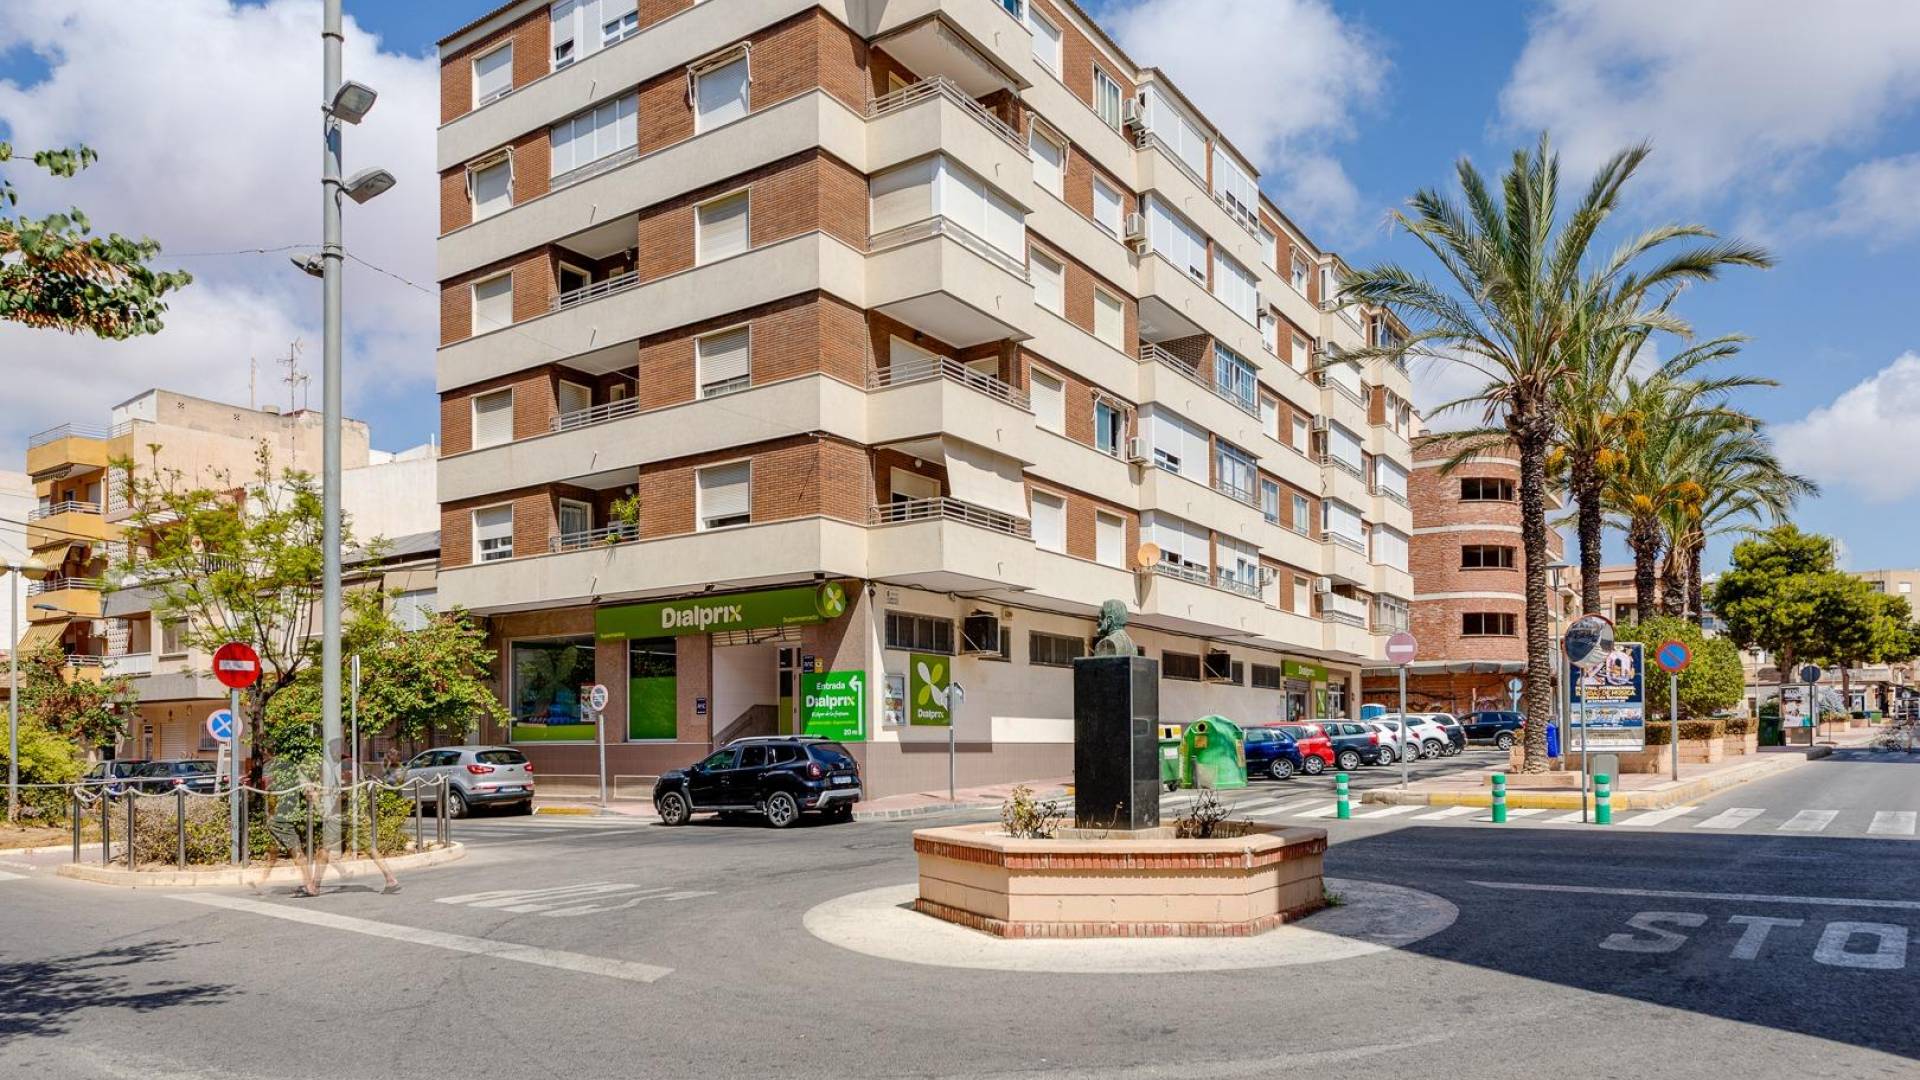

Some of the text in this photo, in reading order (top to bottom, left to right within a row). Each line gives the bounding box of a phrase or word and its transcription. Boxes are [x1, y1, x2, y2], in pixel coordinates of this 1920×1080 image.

[661, 605, 743, 631] Dialprix
[816, 681, 846, 690] Entrada
[806, 695, 856, 710] Dialprix
[1598, 912, 1908, 970] STO
